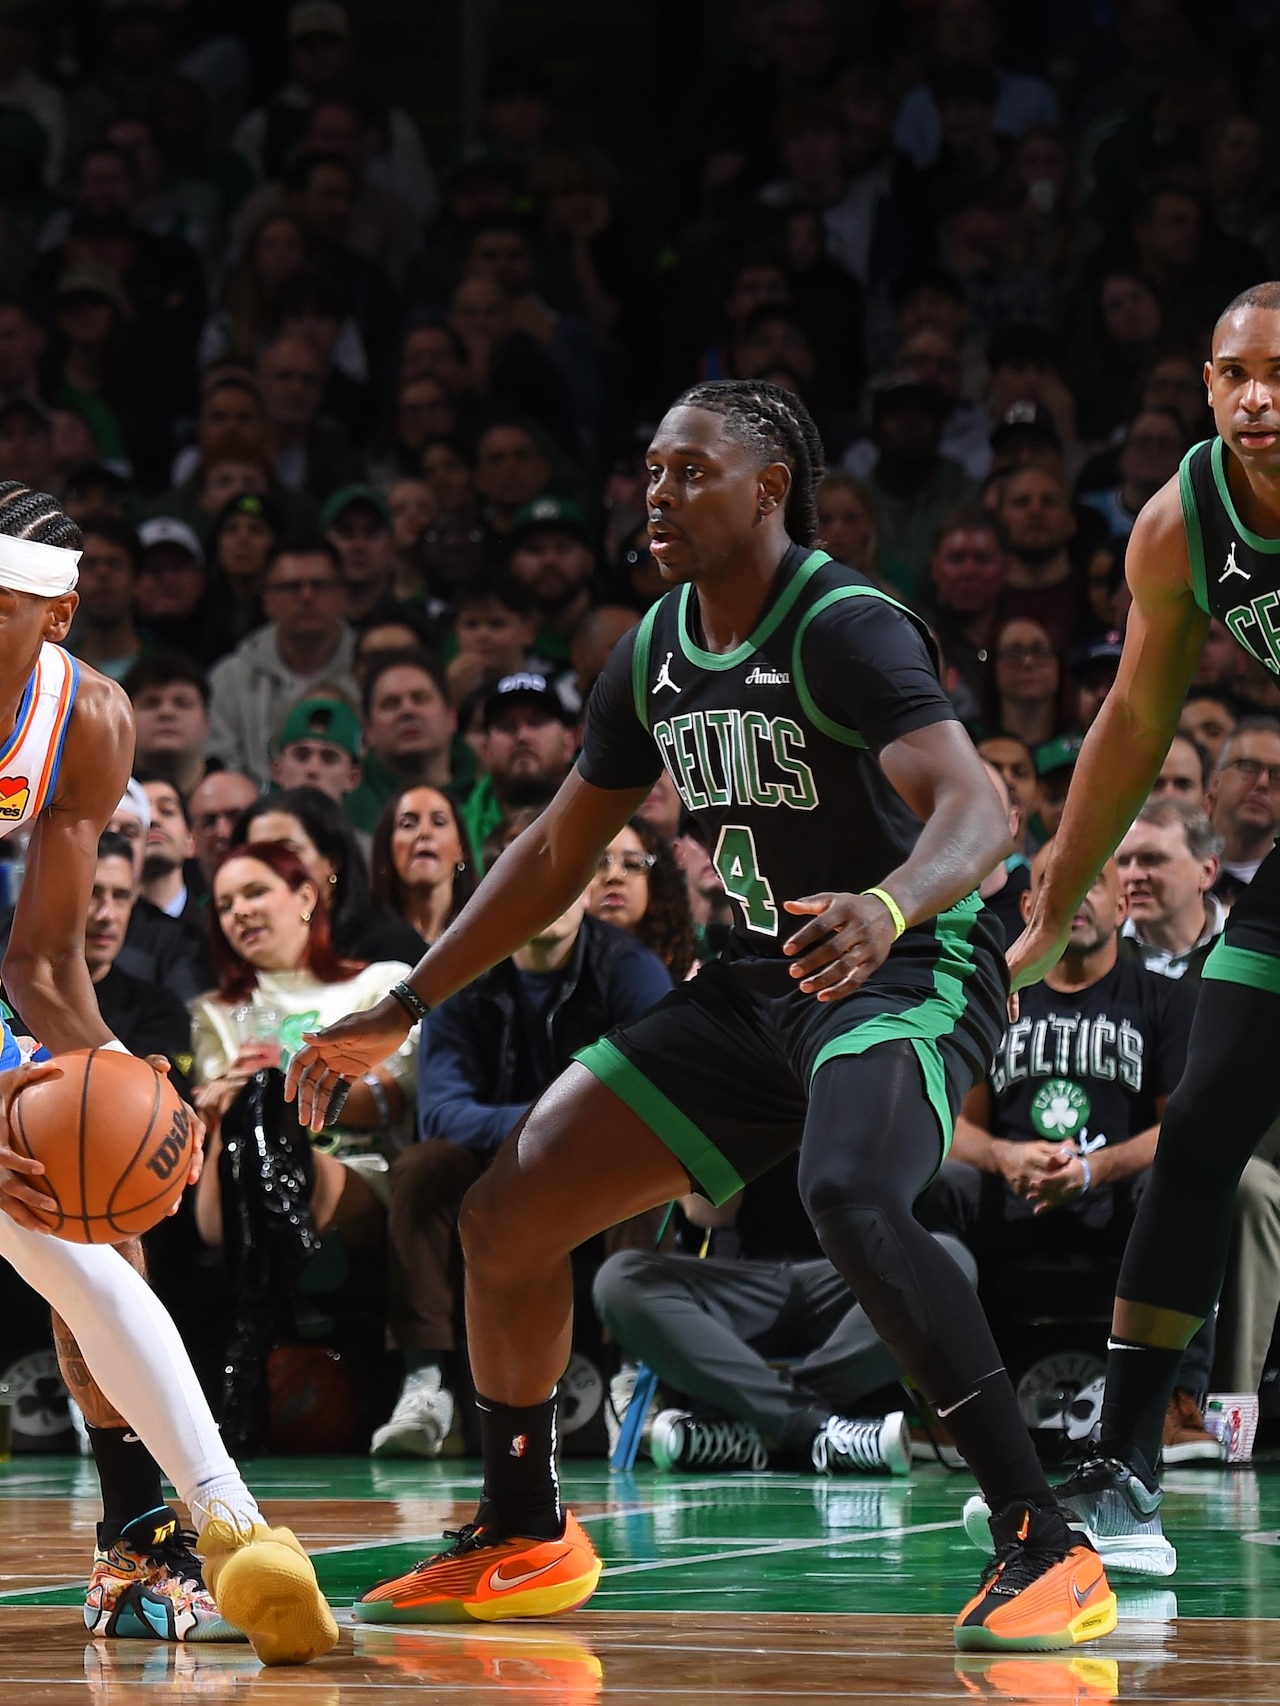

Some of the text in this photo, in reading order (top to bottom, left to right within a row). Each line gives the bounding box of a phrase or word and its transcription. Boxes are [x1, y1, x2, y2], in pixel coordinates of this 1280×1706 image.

[745, 666, 791, 685] Amica
[652, 708, 820, 812] CELTICS
[713, 824, 779, 938] 4
